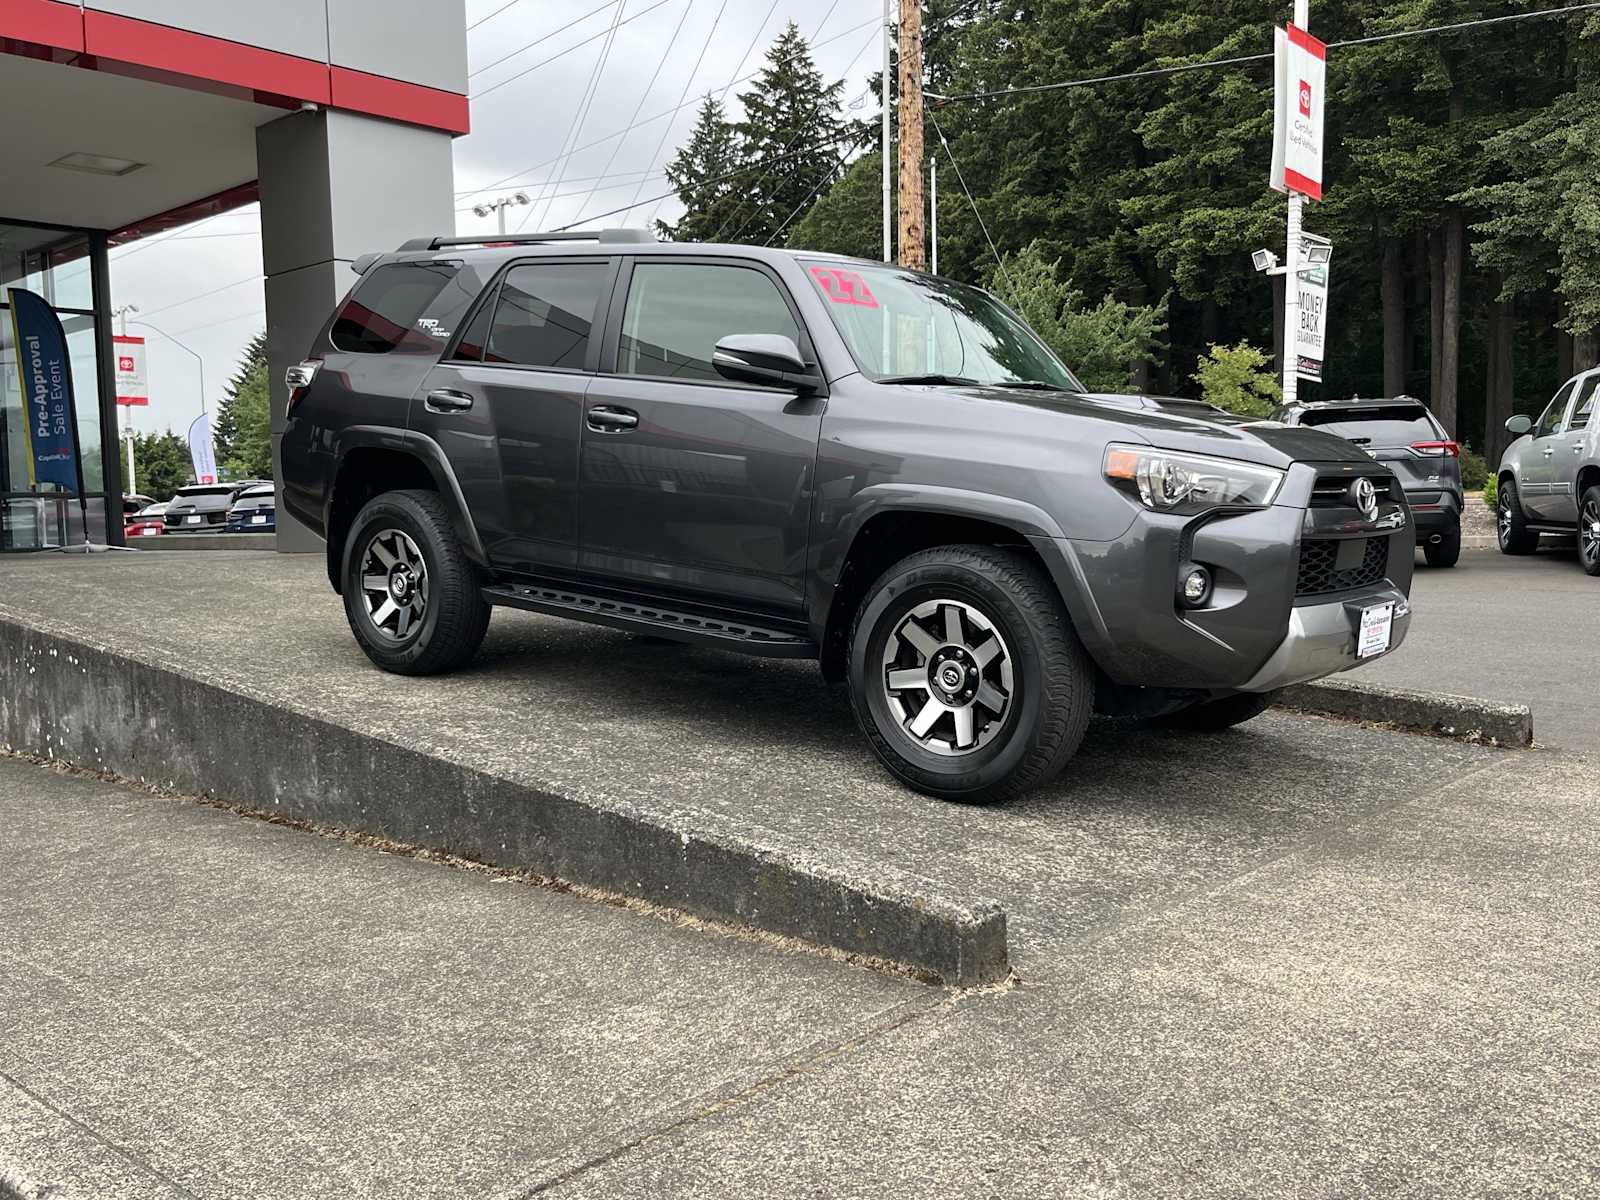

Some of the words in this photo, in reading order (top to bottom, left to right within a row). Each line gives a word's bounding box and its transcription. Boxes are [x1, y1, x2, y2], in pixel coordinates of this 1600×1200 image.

[816, 270, 875, 302] 22
[1298, 291, 1324, 314] MONEY
[418, 318, 439, 329] TRD
[1301, 311, 1319, 333] BACK
[26, 335, 51, 438] Pre-Approval
[48, 359, 63, 400] Event
[51, 404, 66, 435] Sale
